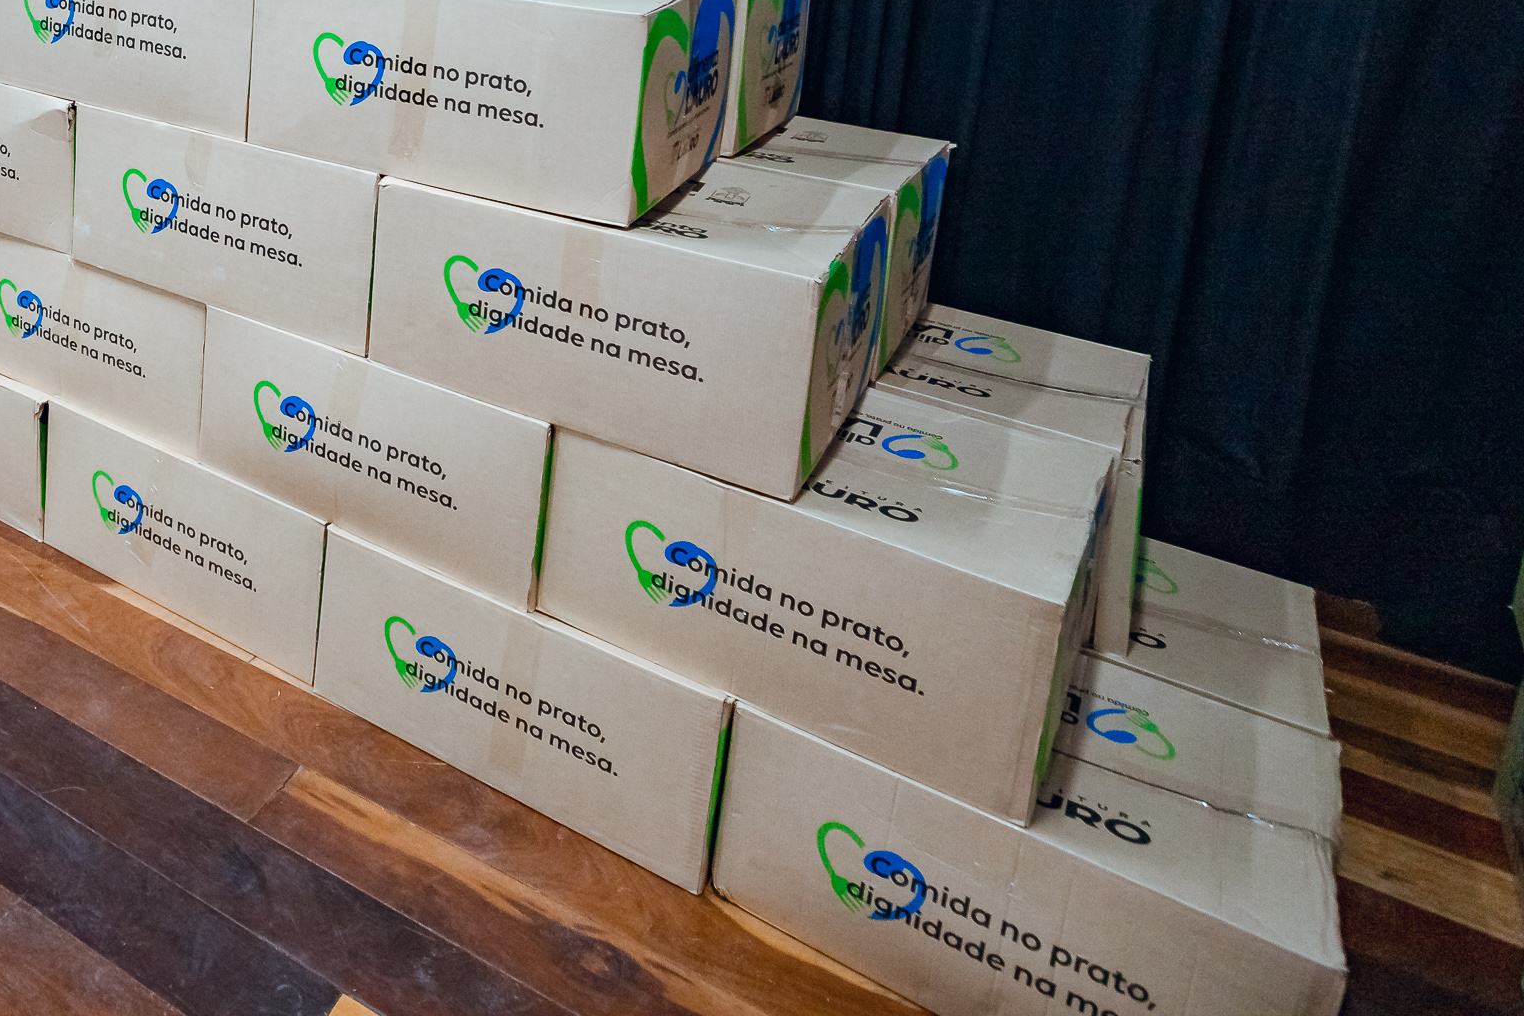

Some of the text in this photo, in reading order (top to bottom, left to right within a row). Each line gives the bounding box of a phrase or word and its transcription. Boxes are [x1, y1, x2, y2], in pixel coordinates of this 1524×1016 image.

[39, 15, 186, 60] dignidade na mesa.
[108, 7, 128, 22] no
[130, 11, 178, 34] prato,
[335, 73, 544, 129] dignidade na mesa.
[349, 48, 532, 98] Comida no prato,
[139, 207, 303, 268] dignidade na mesa.
[150, 185, 293, 241] Comida no prato,
[19, 296, 138, 355] Comida no prato,
[468, 299, 704, 383] dignidade na mesa.
[485, 274, 691, 349] Comida no prato,
[11, 314, 146, 380] dignidade na mesa.
[882, 364, 992, 398] URO
[271, 424, 457, 512] dignidade na mesa.
[284, 403, 447, 481] Comida no prato,
[117, 491, 248, 567] Comida no prato,
[802, 480, 920, 523] URO
[825, 479, 923, 513] EITURA
[107, 509, 257, 594] dignidade na mesa.
[651, 572, 924, 697] dignidade na mesa.
[671, 548, 910, 659] Comida no prato,
[405, 661, 618, 778] dignidade na mesa.
[420, 641, 606, 744] Comida no prato,
[1036, 793, 1152, 846] URO
[846, 880, 1057, 998] dignidade na
[870, 855, 1157, 1012] Comida no prato,
